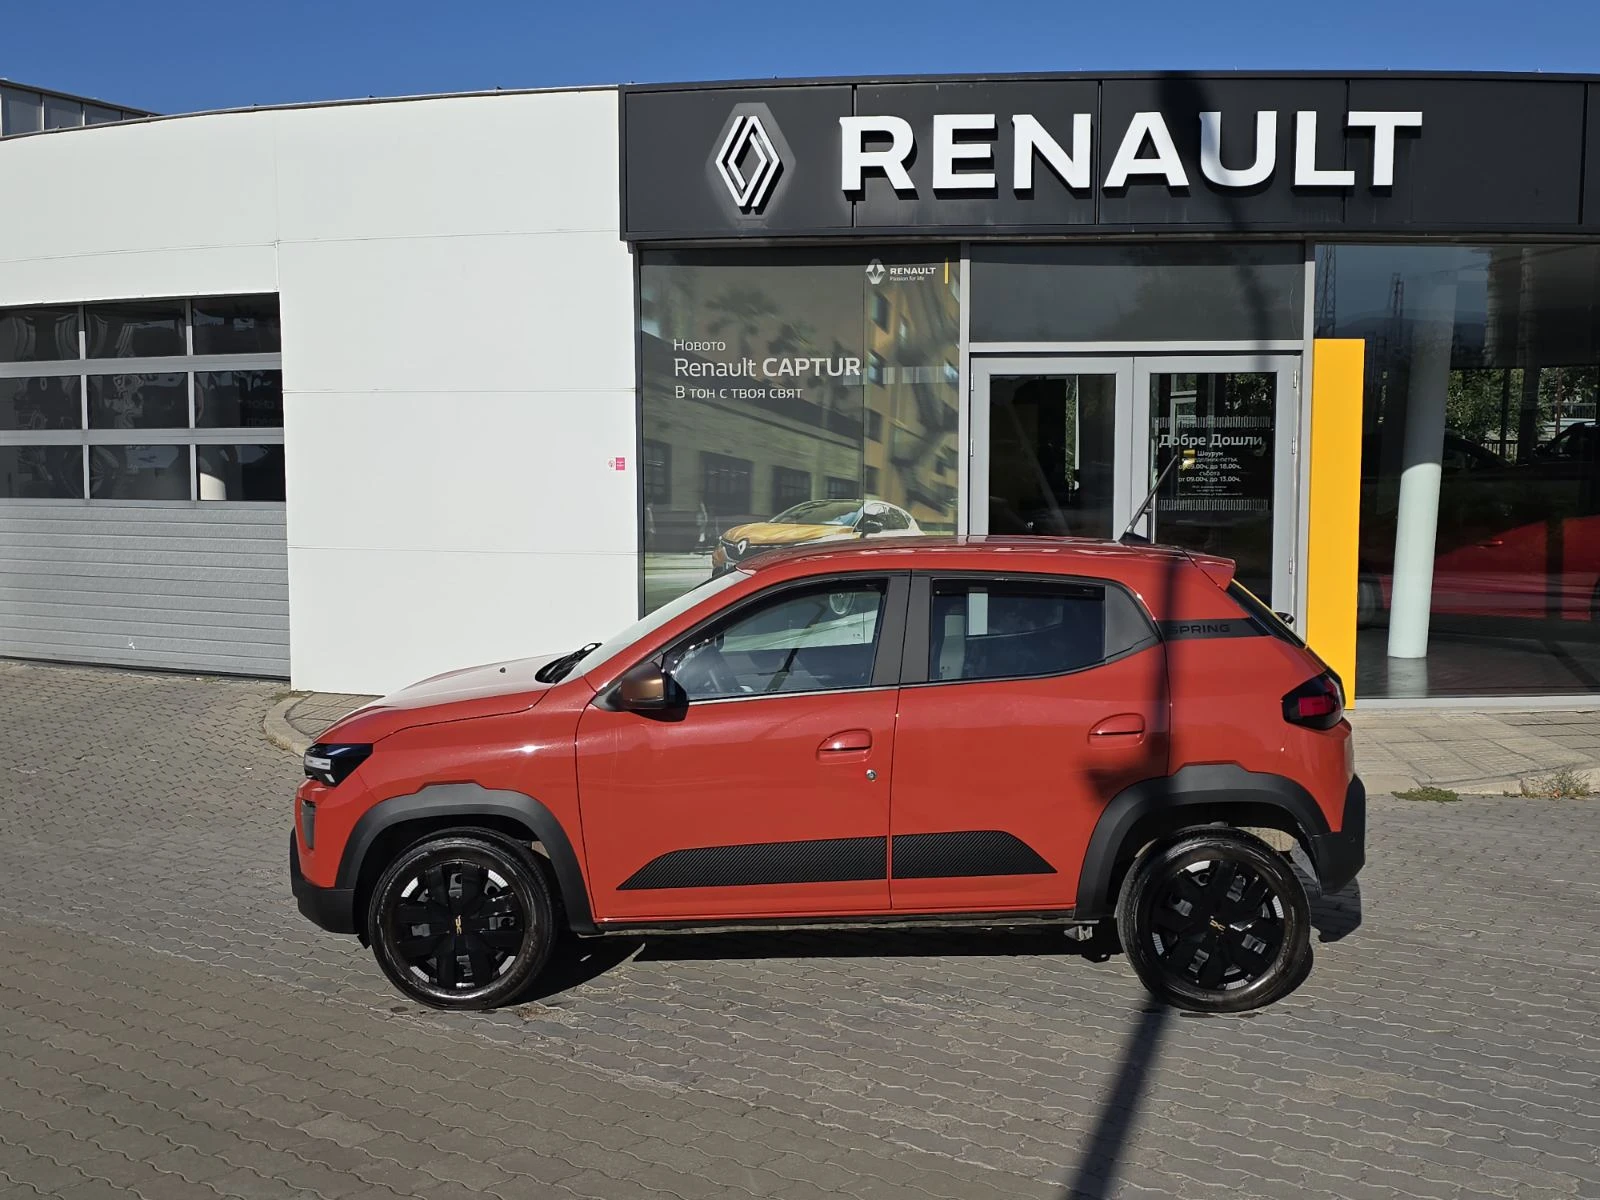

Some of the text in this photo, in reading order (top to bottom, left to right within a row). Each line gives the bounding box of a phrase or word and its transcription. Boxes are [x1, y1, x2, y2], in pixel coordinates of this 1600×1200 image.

[839, 110, 1423, 191] RENAULT
[890, 267, 936, 275] RENAULT
[673, 338, 726, 351] Новото
[674, 357, 861, 377] Renault CAPTUR
[675, 385, 804, 399] В тон с твоя свят
[1158, 433, 1263, 449] Добре Дошли
[1168, 623, 1231, 634] SPRING
